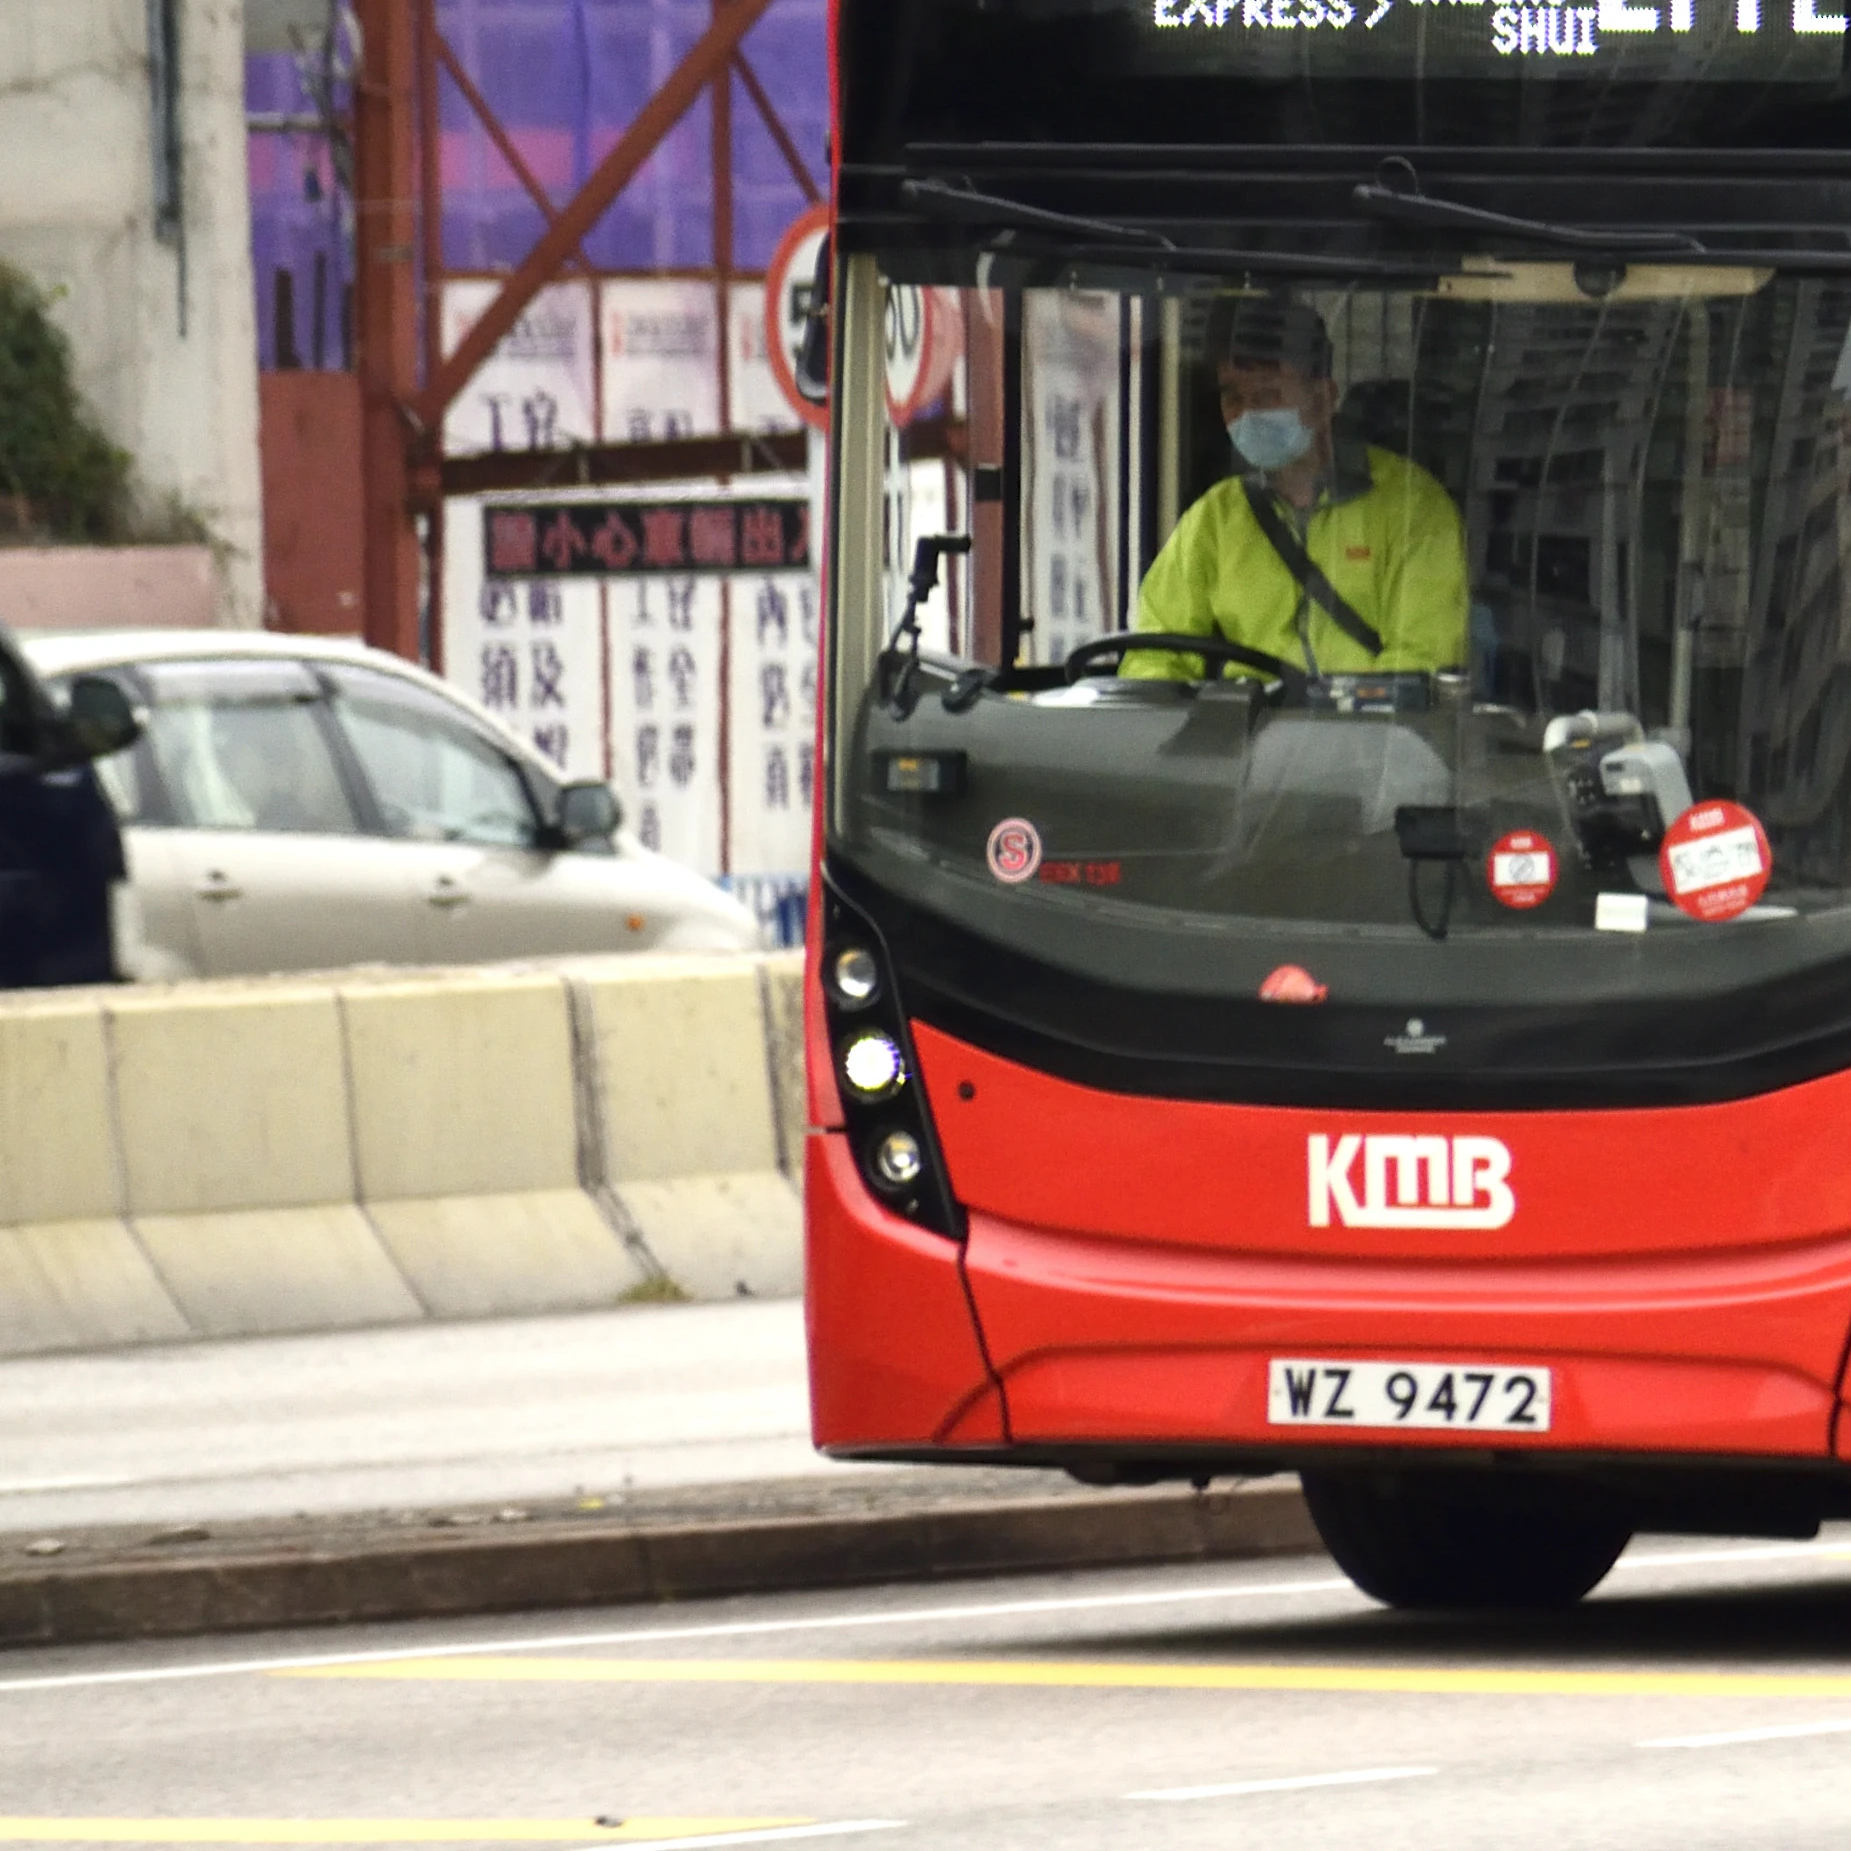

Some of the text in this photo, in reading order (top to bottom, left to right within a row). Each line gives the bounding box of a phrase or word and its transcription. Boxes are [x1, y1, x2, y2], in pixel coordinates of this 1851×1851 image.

[1491, 5, 1600, 55] SHUI
[1308, 1133, 1516, 1230] KMB
[1285, 1367, 1538, 1425] WZ 9472
